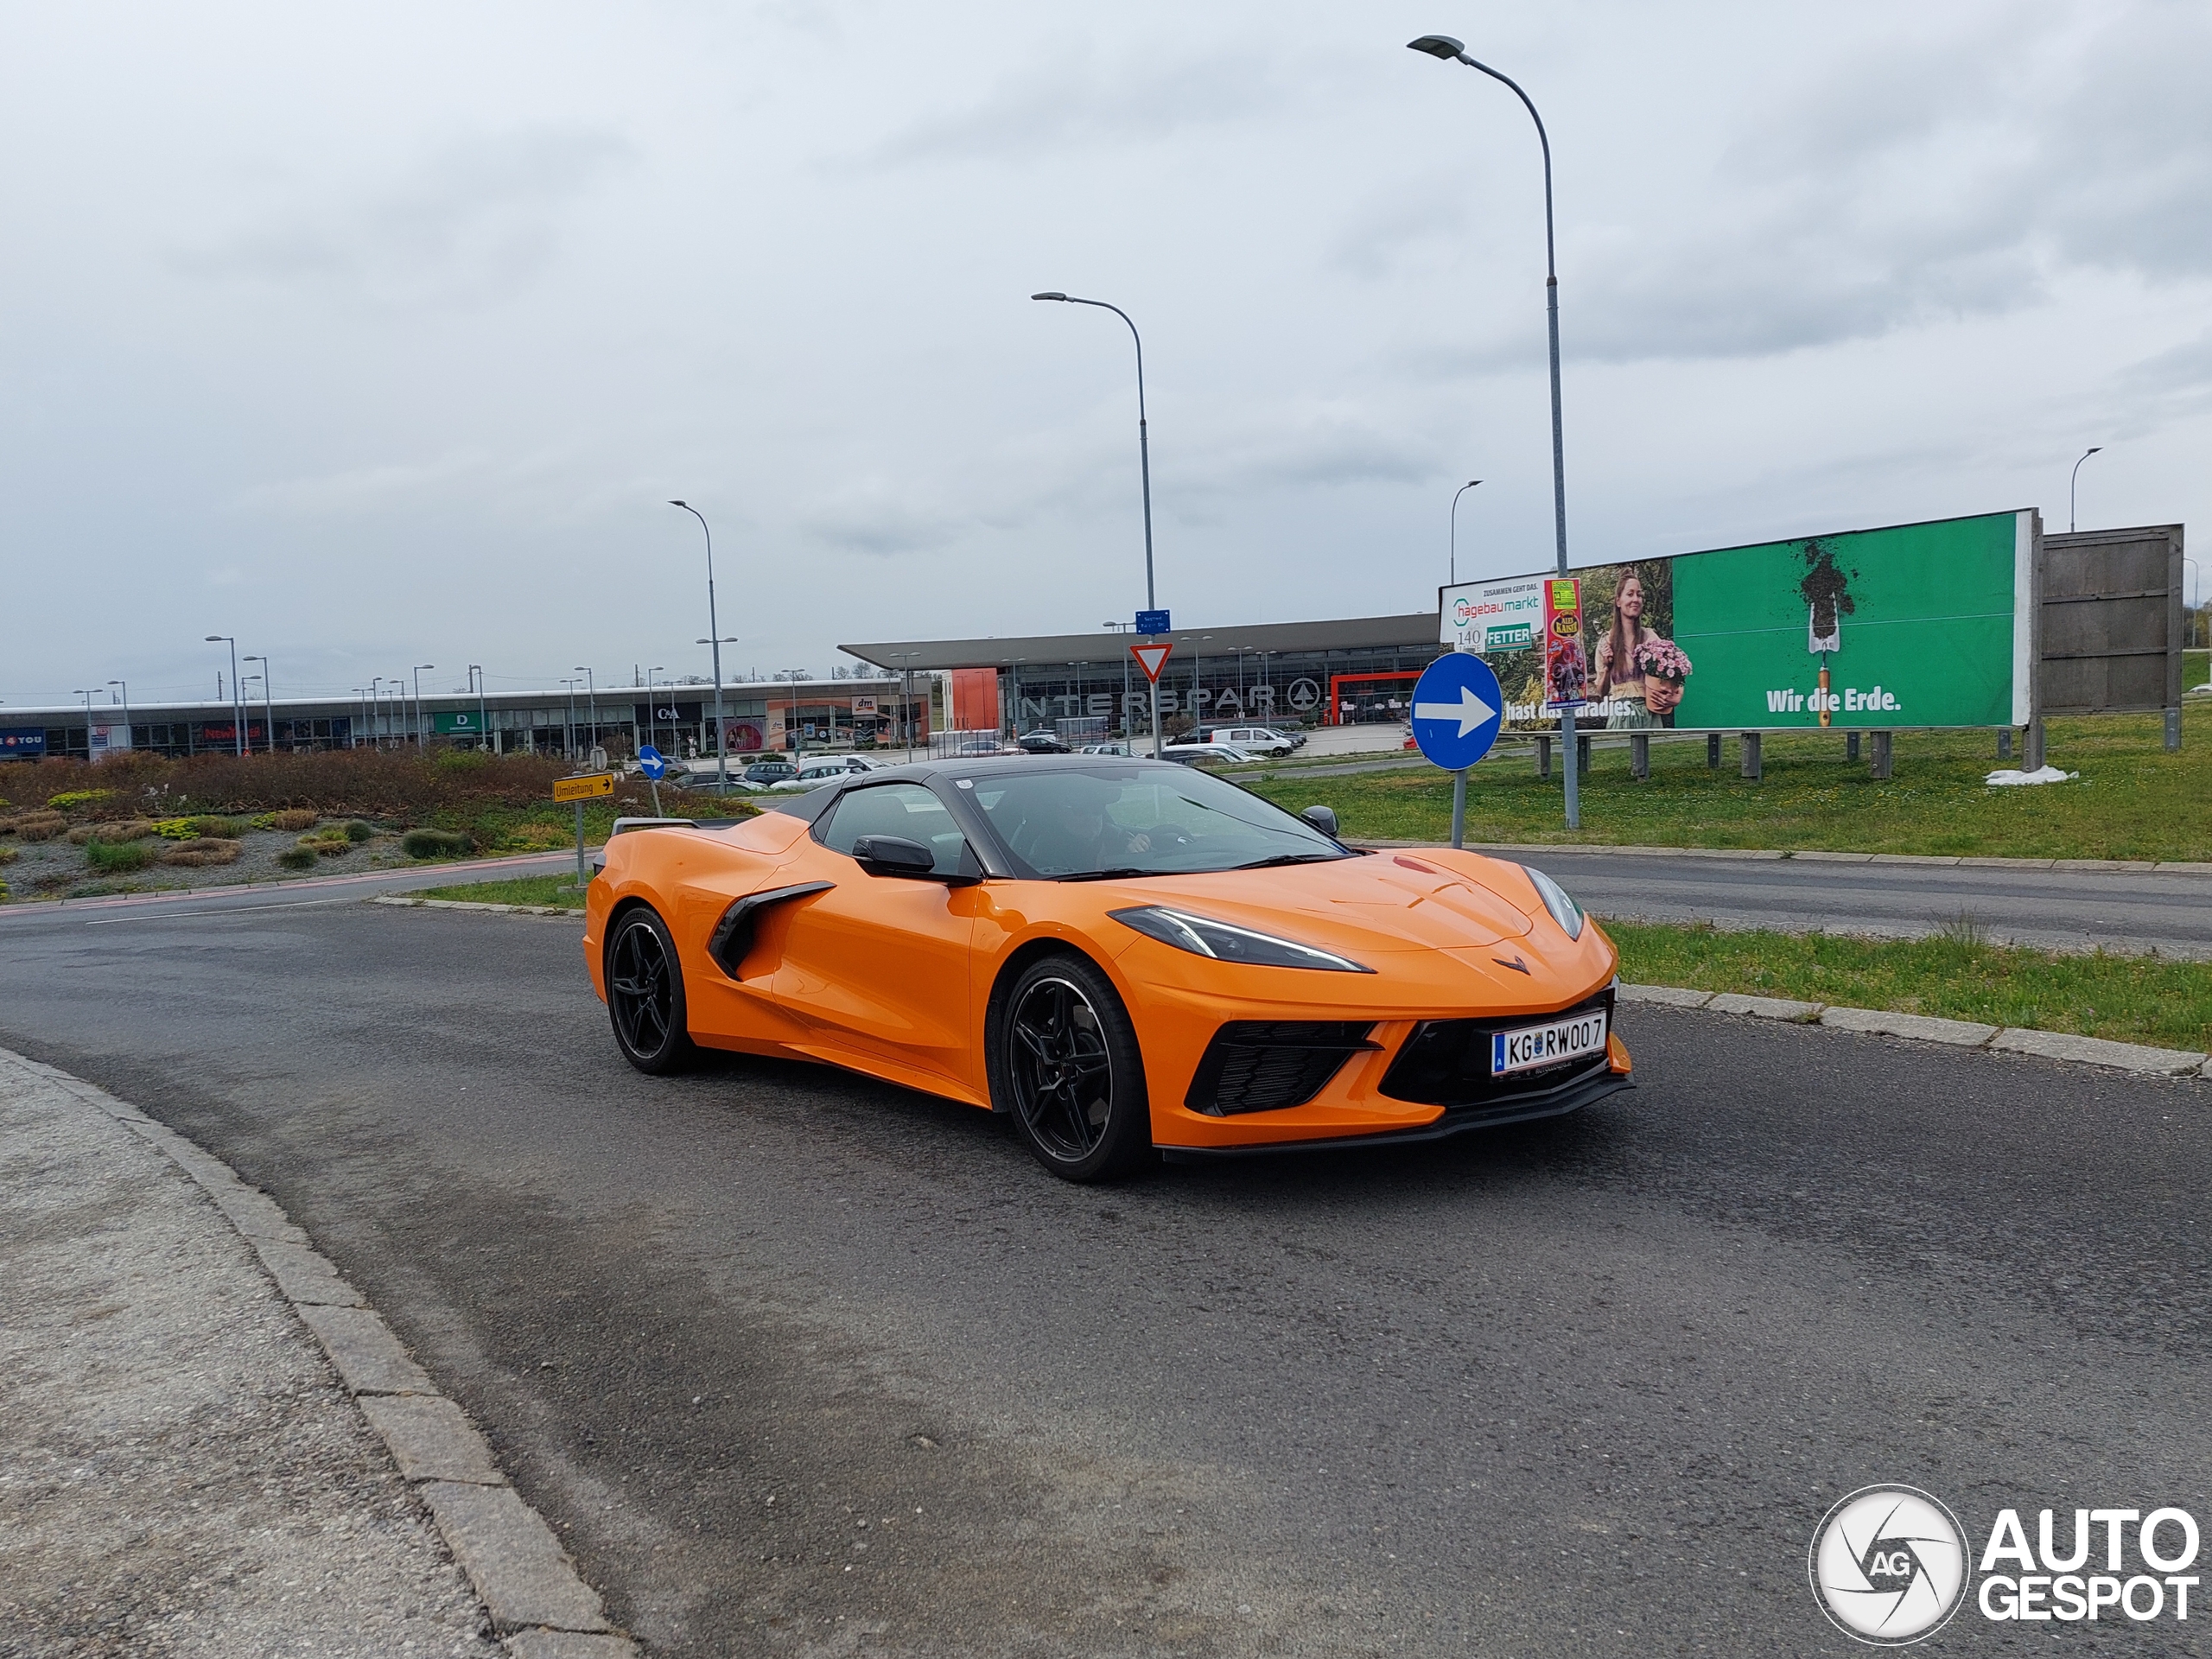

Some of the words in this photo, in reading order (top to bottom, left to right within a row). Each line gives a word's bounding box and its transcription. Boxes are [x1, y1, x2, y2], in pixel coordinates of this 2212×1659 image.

[1484, 587, 1512, 597] ZUSAMMEN
[1459, 596, 1539, 619] hagebaumarkt
[1458, 630, 1481, 645] 140
[1488, 628, 1529, 645] FETTER
[1007, 685, 1276, 719] INTERSPAR
[1766, 689, 1804, 712] Wir
[1808, 688, 1840, 712] die
[1845, 685, 1901, 711] Erde.
[658, 708, 681, 720] C&A
[1505, 701, 1536, 720] hast
[1574, 696, 1636, 717] aradies.
[456, 715, 468, 725] D
[556, 783, 594, 797] Umleitung
[1510, 1034, 1532, 1065] KG
[1497, 1058, 1503, 1066] A
